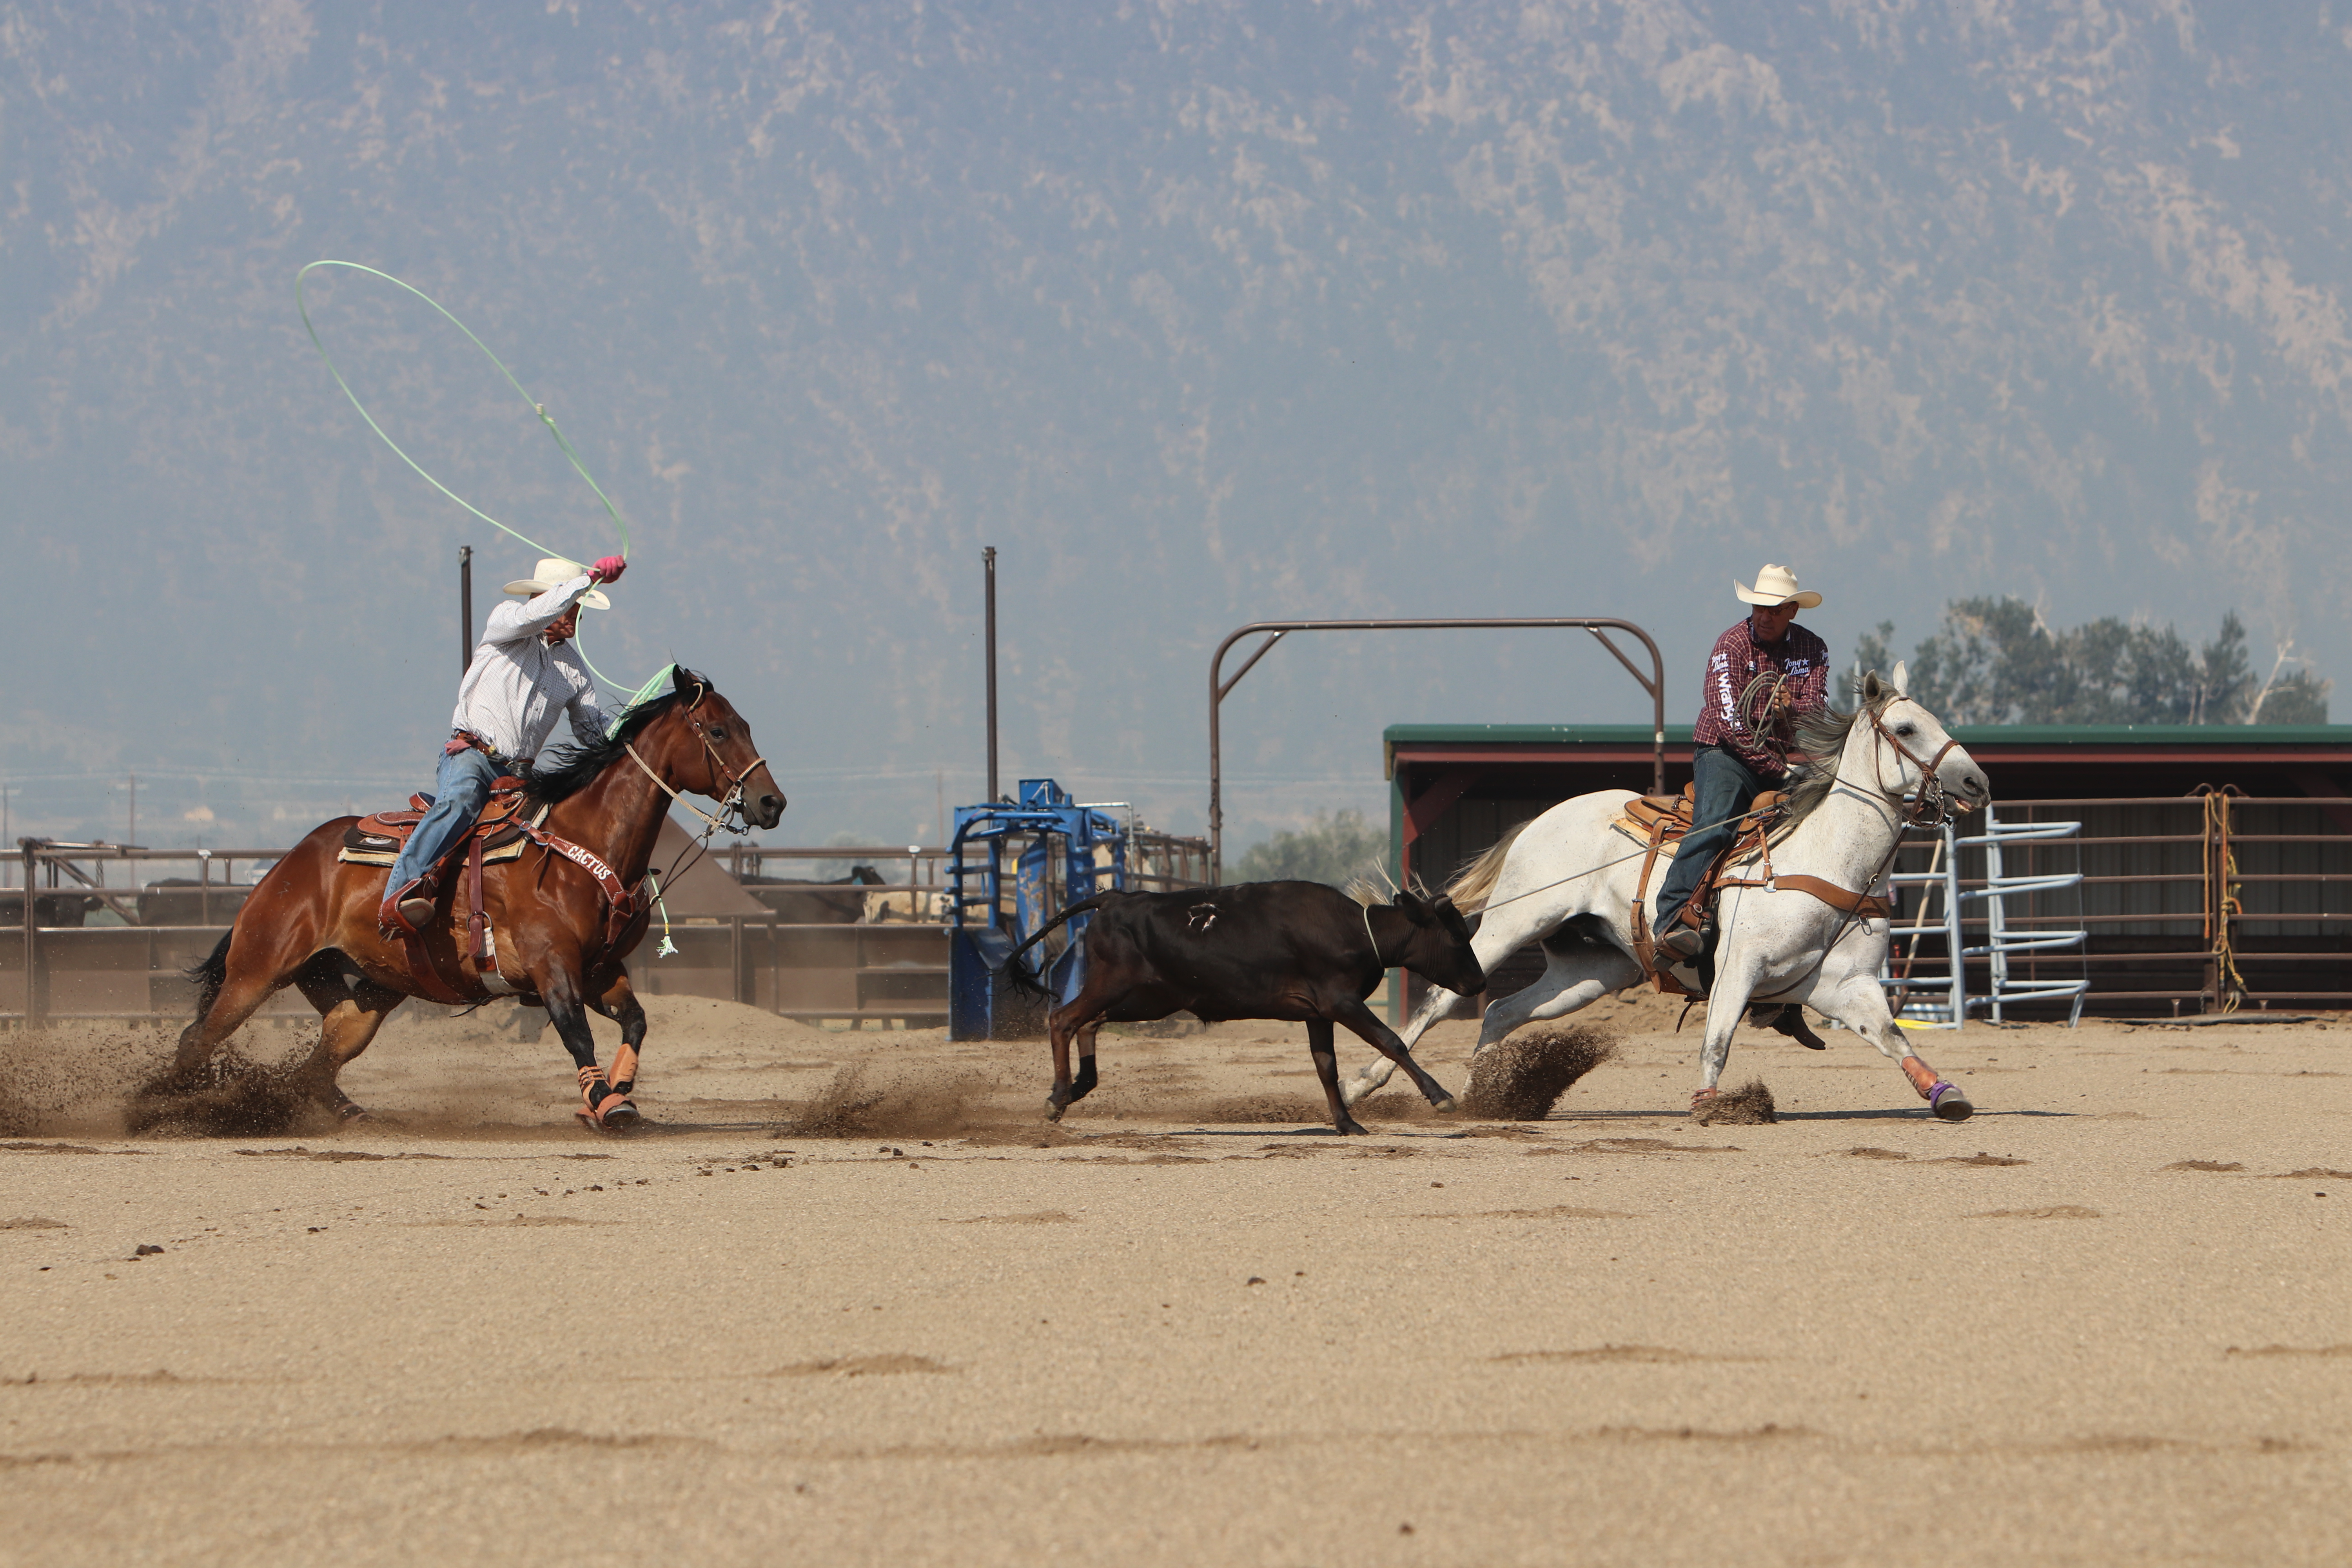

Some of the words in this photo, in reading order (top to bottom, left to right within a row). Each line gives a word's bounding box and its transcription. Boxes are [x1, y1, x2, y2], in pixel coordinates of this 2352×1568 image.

[1712, 661, 1729, 672] Lama
[1784, 658, 1801, 670] Tony
[1788, 666, 1810, 676] Lama
[1717, 671, 1743, 731] Wrangler
[567, 845, 612, 880] CACTUS
